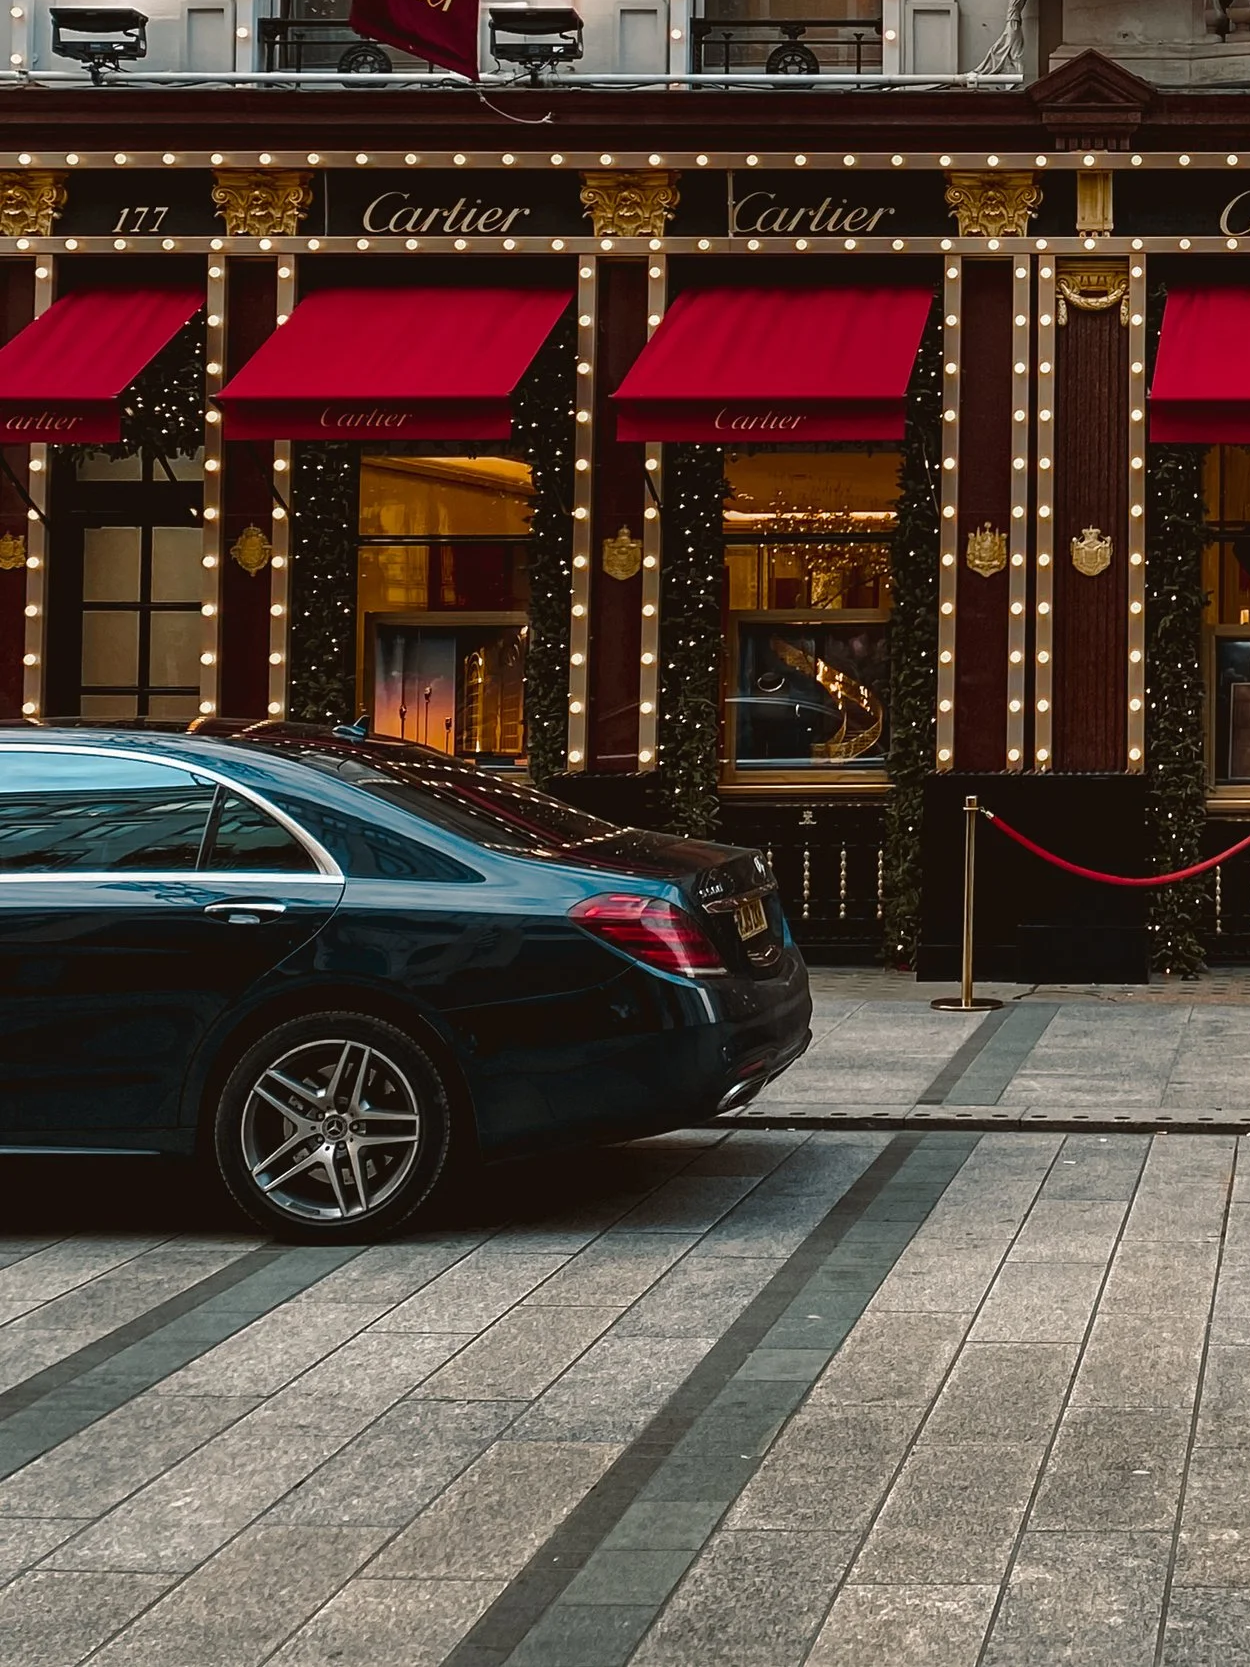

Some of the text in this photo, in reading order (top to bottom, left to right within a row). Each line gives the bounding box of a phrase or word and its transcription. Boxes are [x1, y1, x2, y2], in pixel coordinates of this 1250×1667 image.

[112, 206, 168, 233] 177
[363, 192, 530, 232] Cartier
[732, 192, 895, 232] Cartier
[5, 410, 84, 431] artier
[320, 406, 413, 429] Cartier
[714, 407, 807, 430] Cartier
